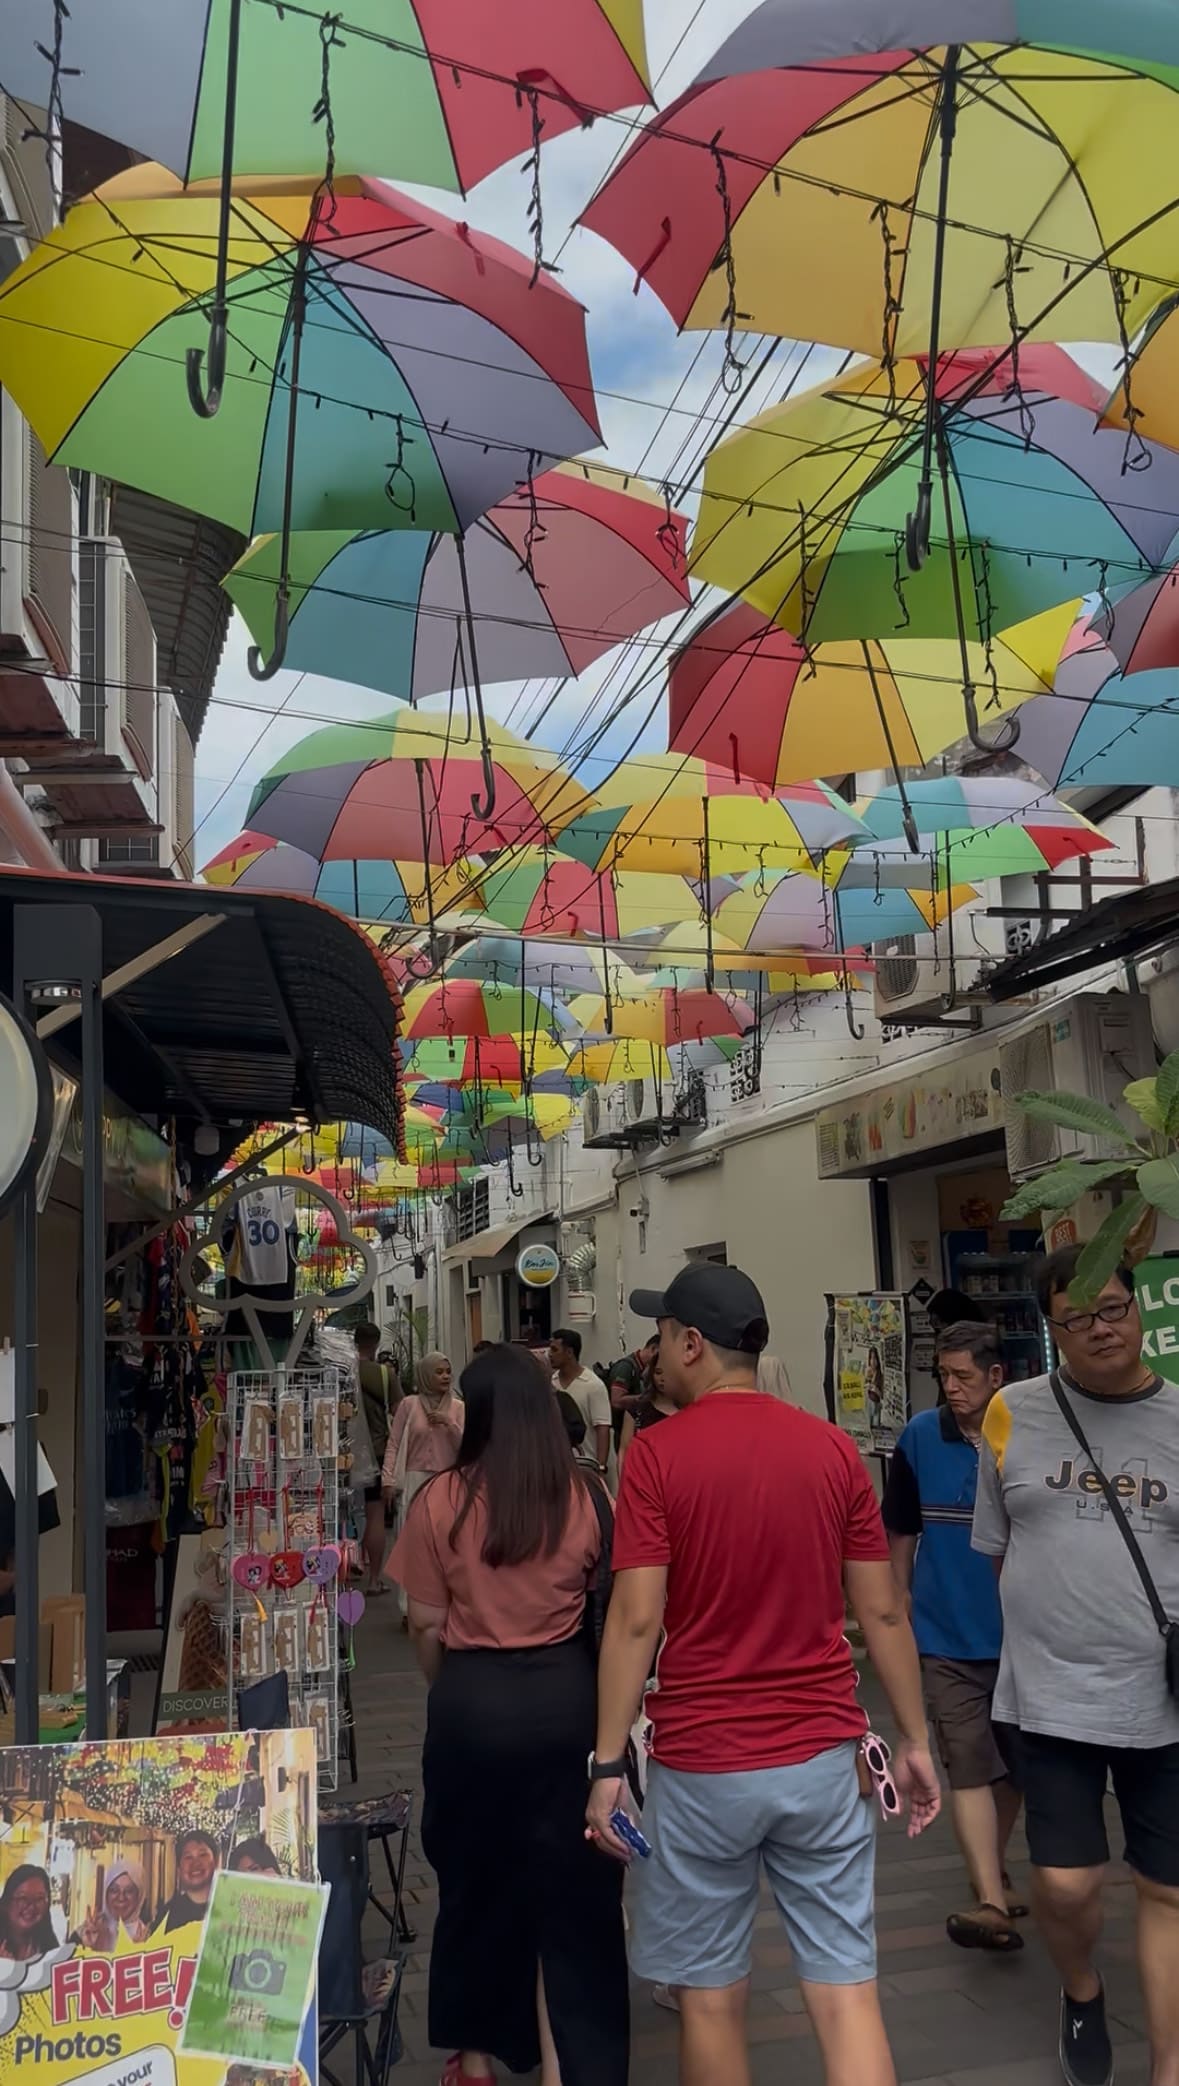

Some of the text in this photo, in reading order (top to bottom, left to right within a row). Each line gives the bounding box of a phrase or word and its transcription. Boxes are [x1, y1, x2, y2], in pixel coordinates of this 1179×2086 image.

[247, 1220, 280, 1246] 30
[1044, 1459, 1169, 1509] Jeep
[52, 1945, 198, 2030] FREE!
[15, 2031, 122, 2065] Photos
[117, 2061, 152, 2086] your
